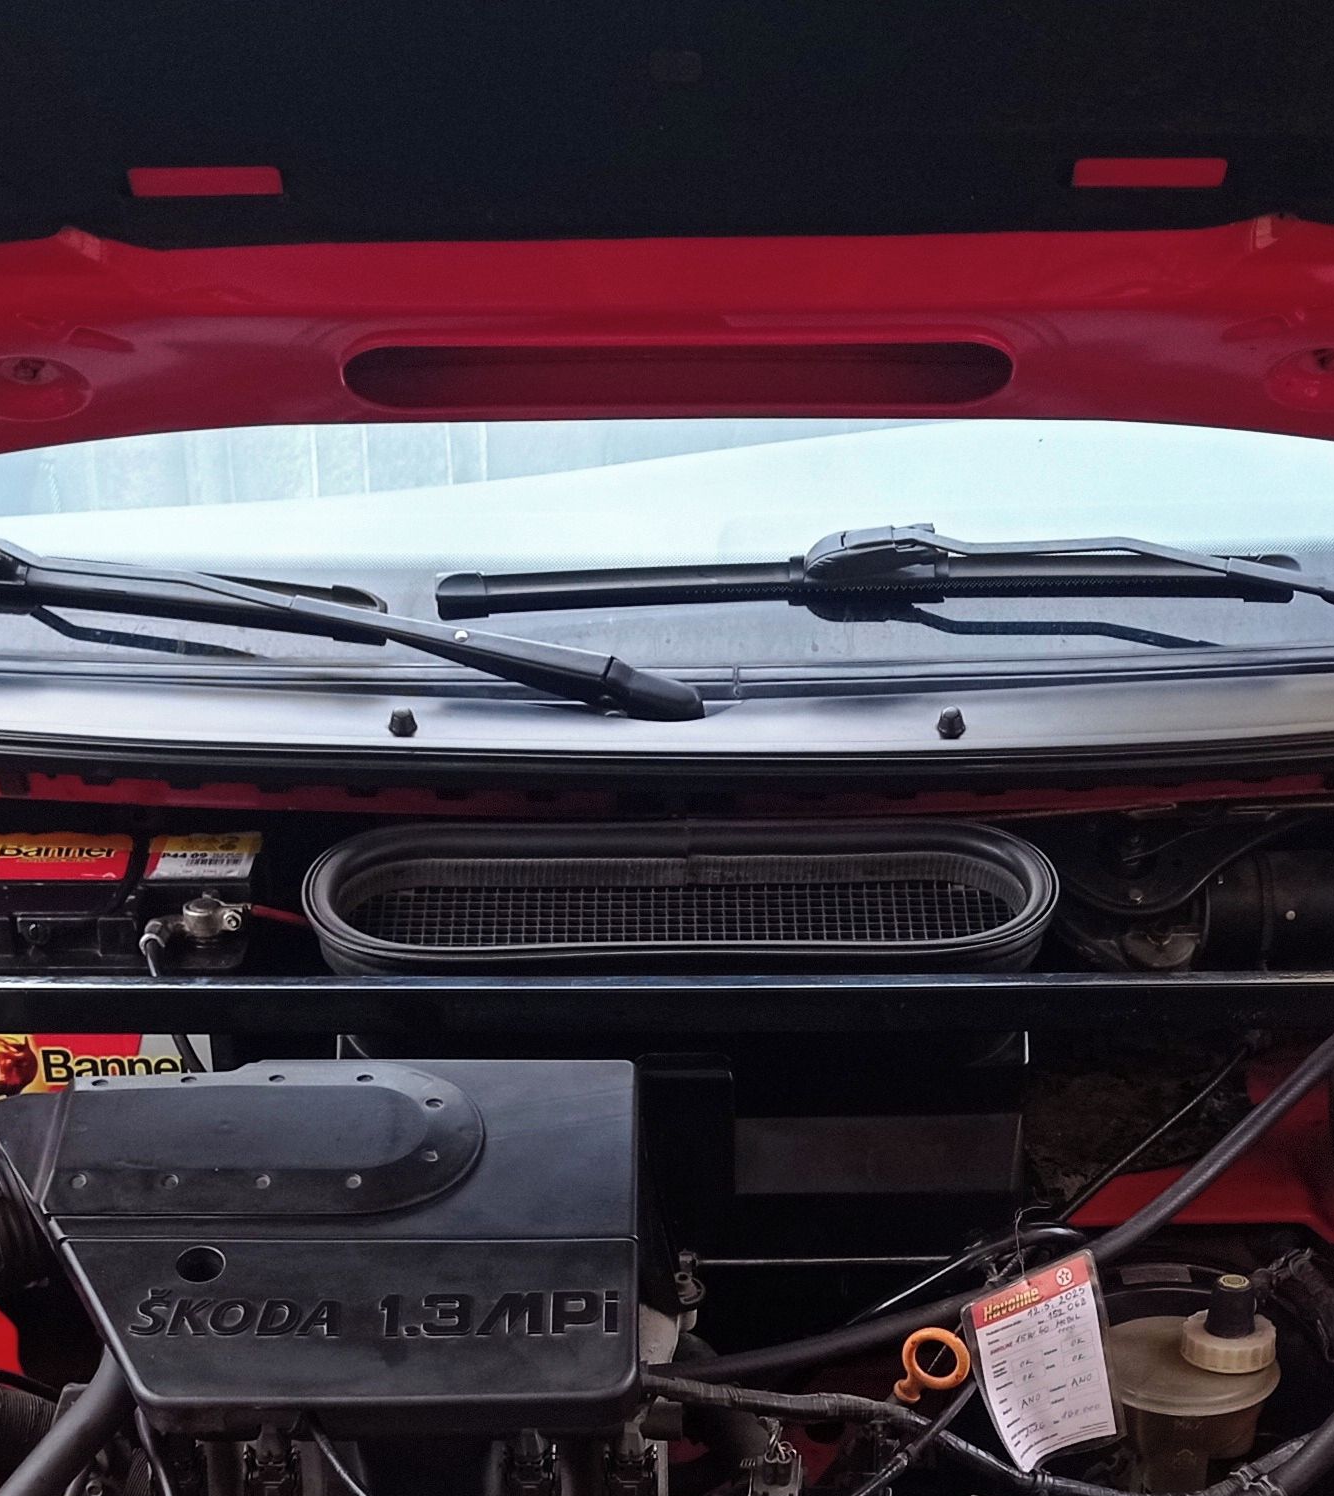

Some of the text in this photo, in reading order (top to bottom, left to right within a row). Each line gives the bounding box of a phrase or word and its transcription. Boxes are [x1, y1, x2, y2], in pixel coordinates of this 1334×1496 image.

[983, 1286, 1041, 1323] Havoline
[1059, 1287, 1086, 1305] 2025
[128, 1288, 341, 1338] ŠKODA
[1021, 1392, 1041, 1409] ANO
